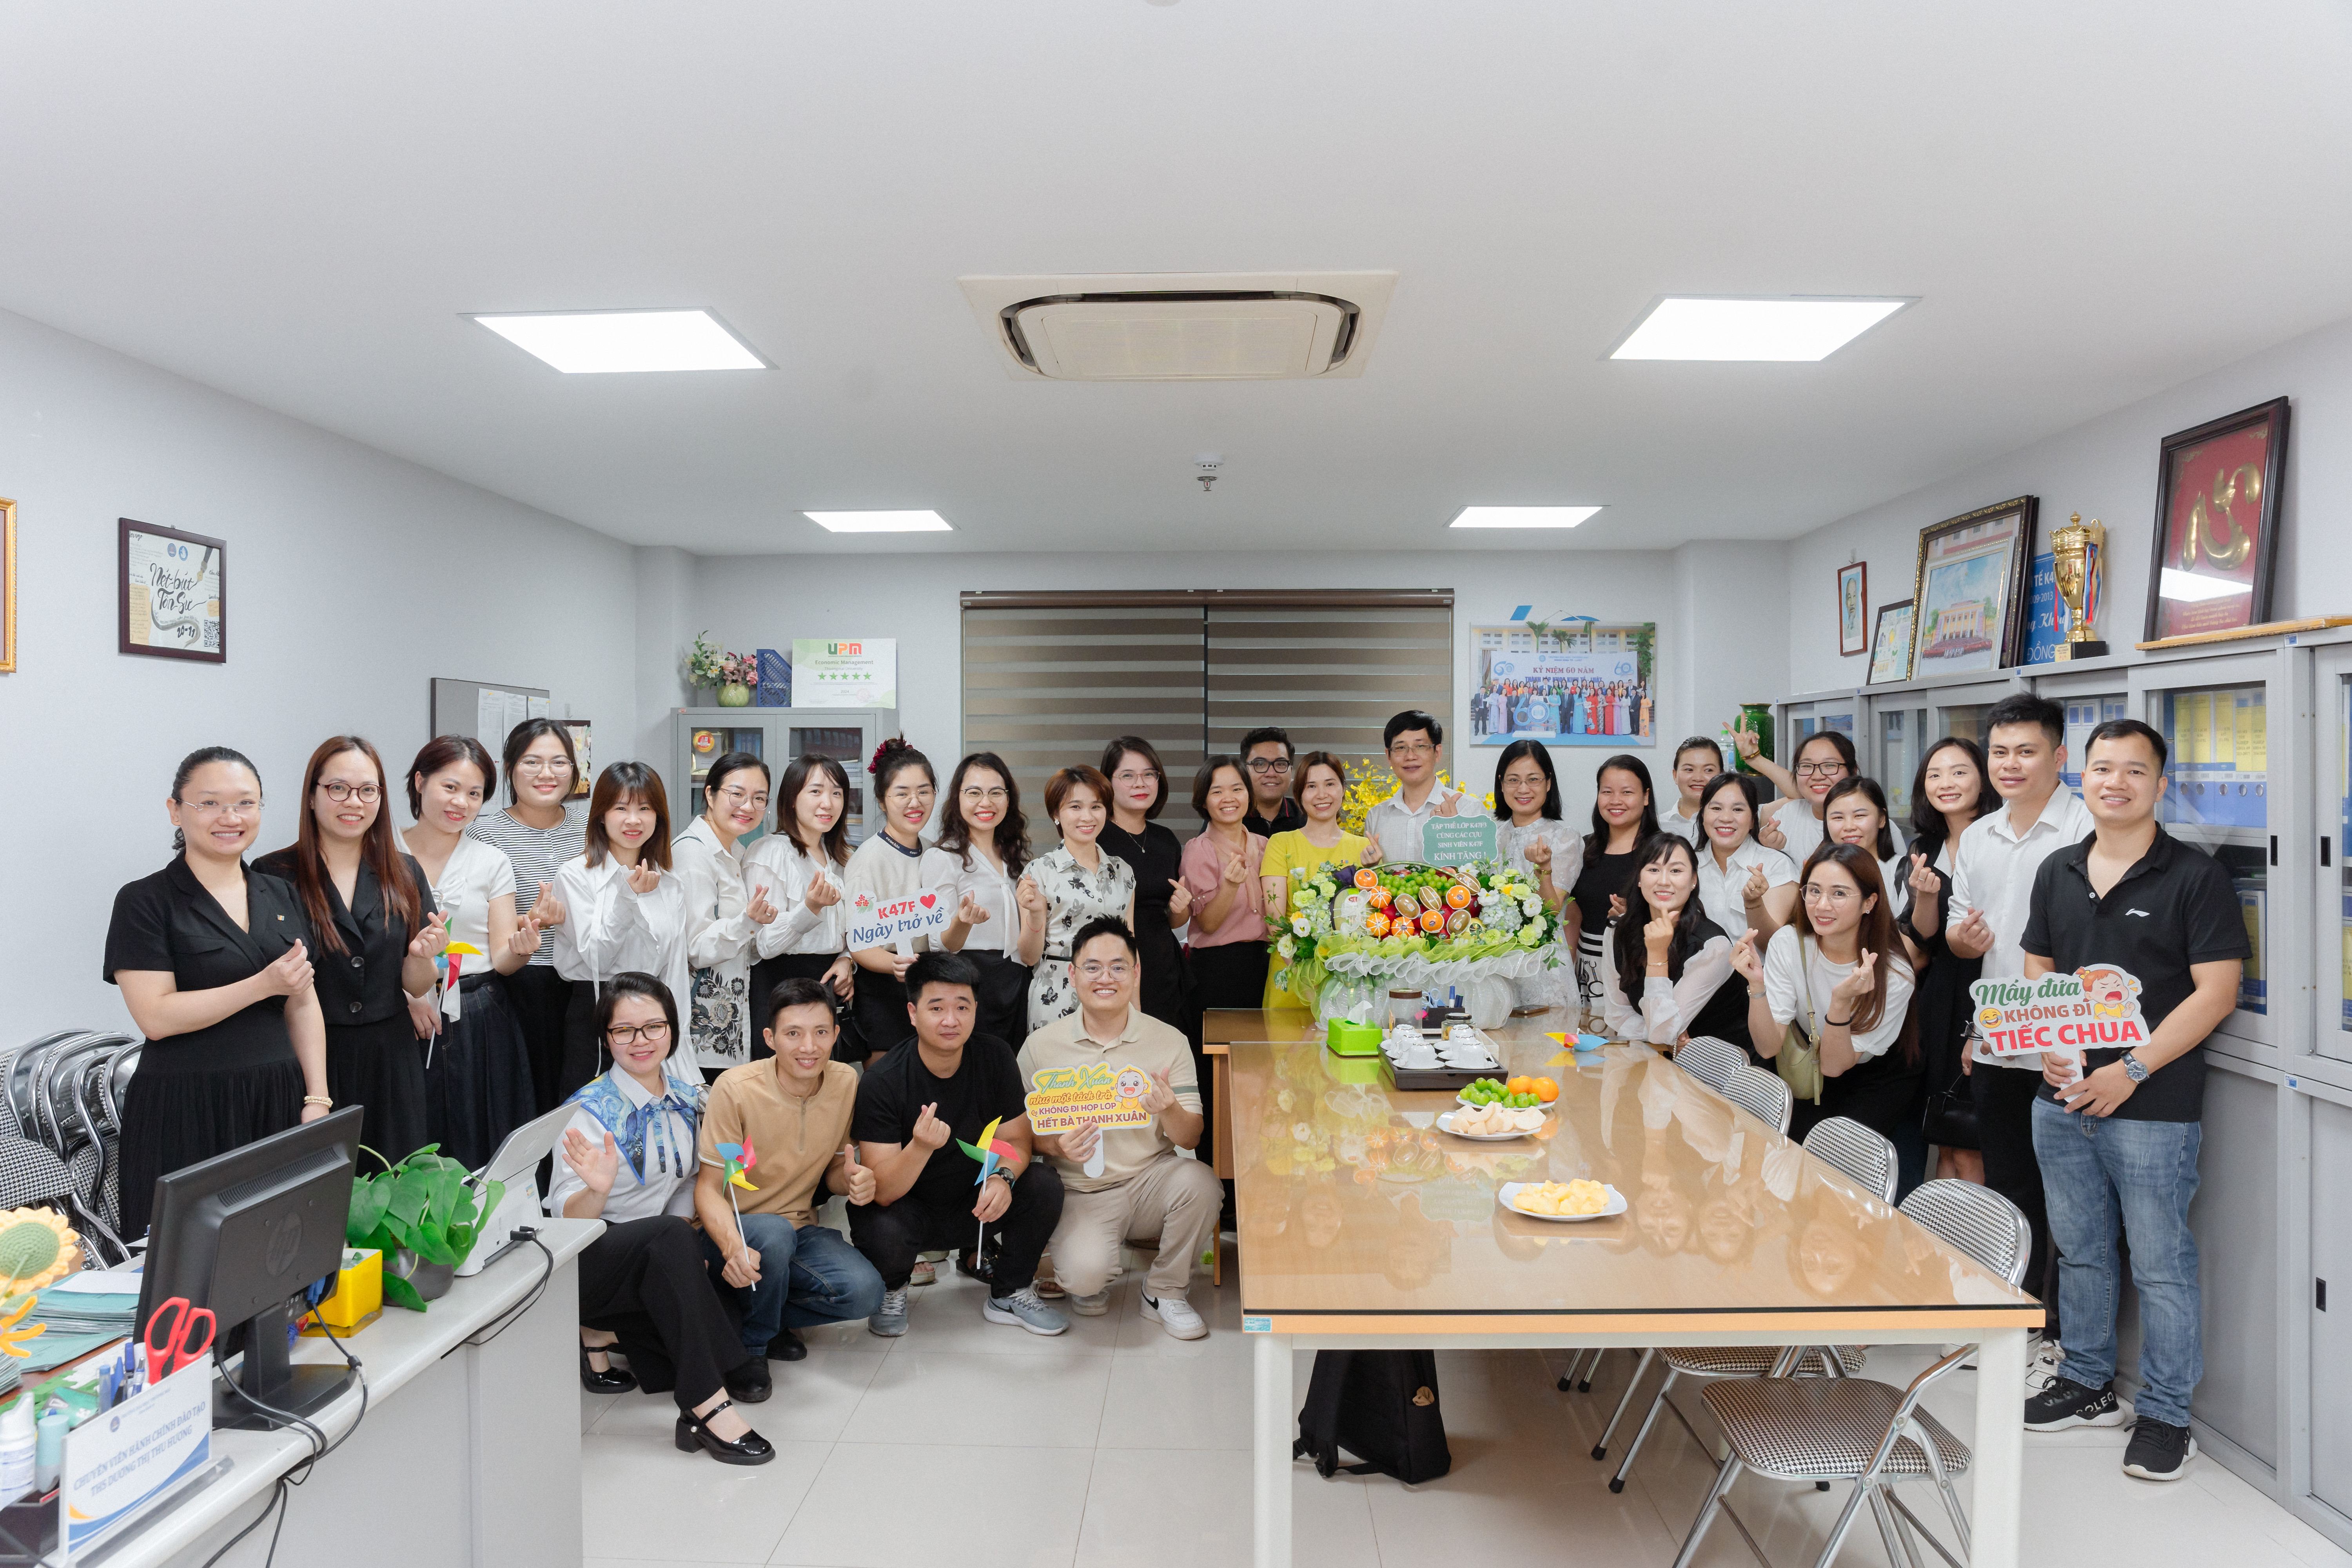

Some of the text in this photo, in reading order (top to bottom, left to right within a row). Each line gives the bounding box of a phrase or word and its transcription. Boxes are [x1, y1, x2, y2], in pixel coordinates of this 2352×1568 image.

[150, 563, 173, 588] Nét
[174, 569, 197, 590] bút
[2034, 570, 2055, 587] TẾ K4
[158, 588, 177, 610] Tôn
[177, 625, 195, 638] 20-11
[828, 643, 862, 655] UPM
[2027, 641, 2055, 661] ĐỒNG
[1533, 665, 1543, 673] KỶ
[1547, 666, 1564, 675] NIỆM
[1434, 851, 1455, 860] KÍNH
[1457, 851, 1482, 861] TẶNG
[878, 901, 915, 919] K47F
[853, 907, 944, 943] Ngày trở về
[1976, 978, 2081, 1007] Mấy đứa
[2004, 1004, 2069, 1023] KHÔNG
[1989, 1021, 2142, 1051] TIẾC CHUA
[1036, 1065, 1113, 1094] Thanh Xuân
[1029, 1089, 1112, 1105] như một tách trà
[1039, 1105, 1069, 1115] KHÔNG
[1081, 1104, 1098, 1112] HỌP
[1038, 1110, 1147, 1129] HẾT BÀ THANH XUÂN
[74, 1463, 107, 1491] CHUYÊN
[109, 1449, 127, 1468] VIÊN
[129, 1434, 151, 1456] HÀNH
[152, 1419, 176, 1441] CHÍNH
[177, 1410, 192, 1426] ĐÀO
[192, 1401, 205, 1417] TẠO
[91, 1478, 107, 1497] THS
[137, 1452, 150, 1468] THỊ
[151, 1443, 166, 1458] THU
